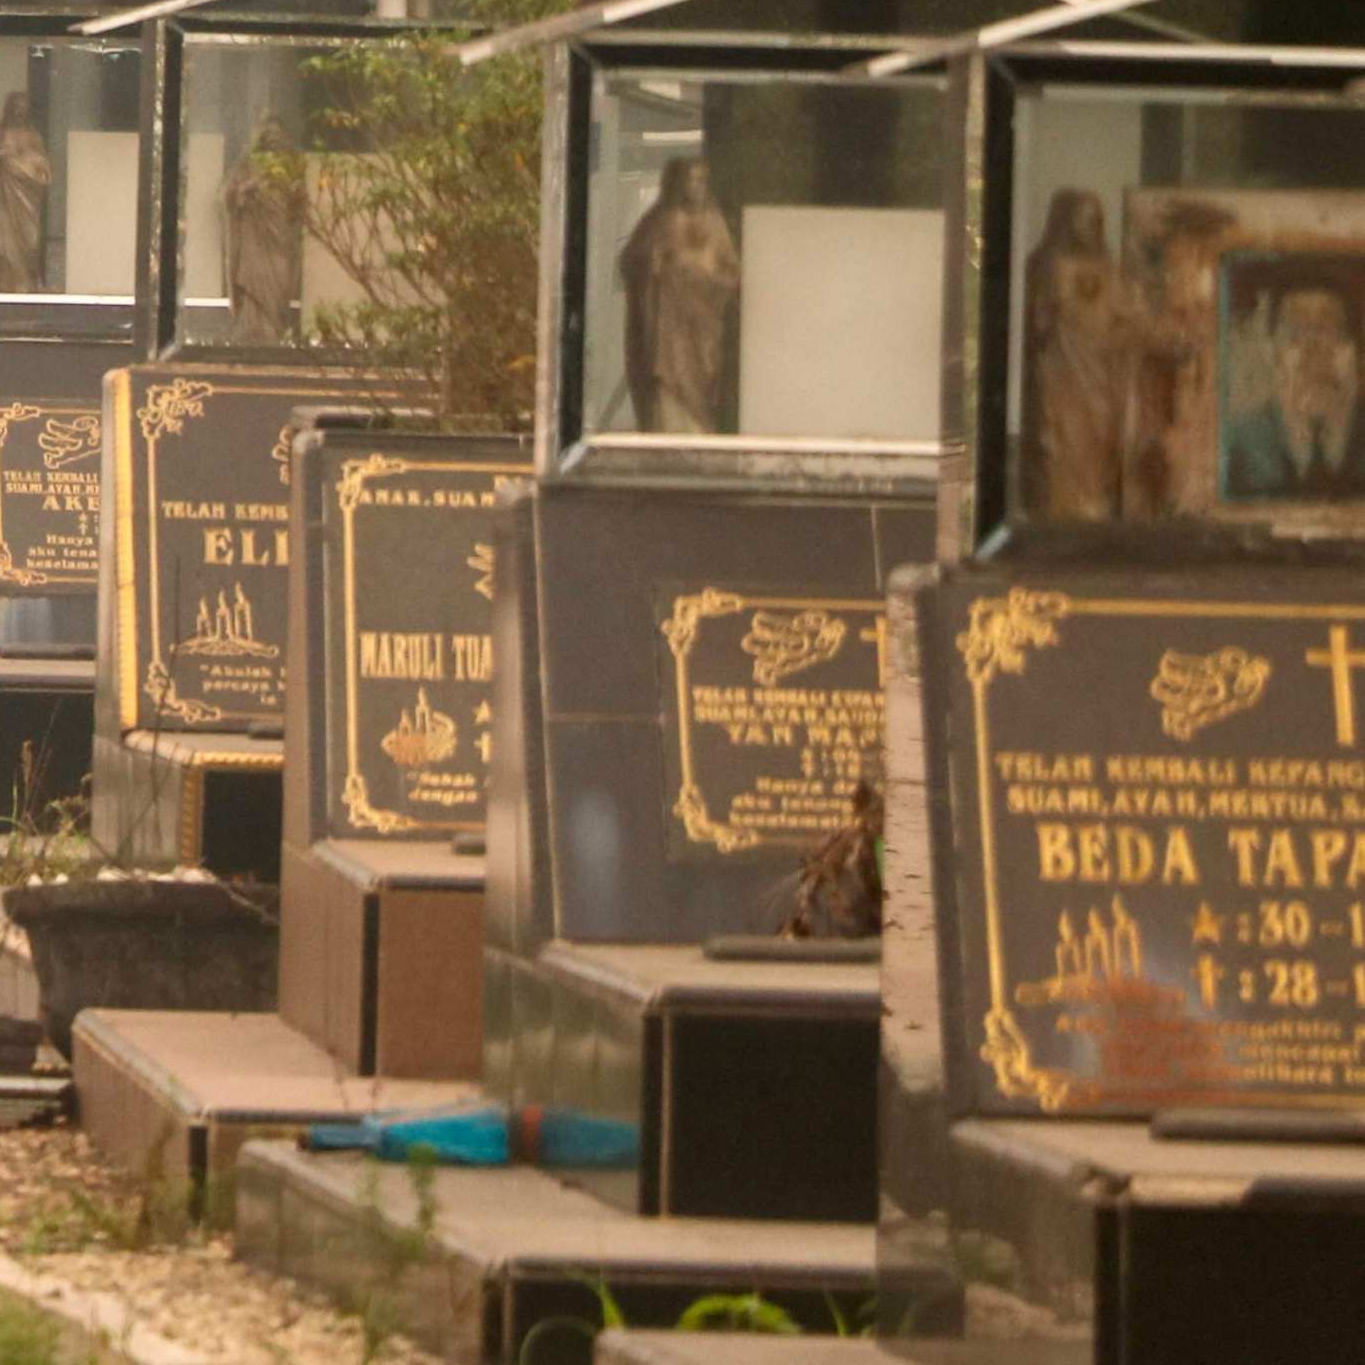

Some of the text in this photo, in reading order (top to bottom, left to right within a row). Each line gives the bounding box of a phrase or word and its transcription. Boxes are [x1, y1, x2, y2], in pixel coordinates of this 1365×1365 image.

[161, 500, 226, 520] TELAH
[360, 631, 444, 680] MARULI
[1036, 821, 1200, 885] BEDA
